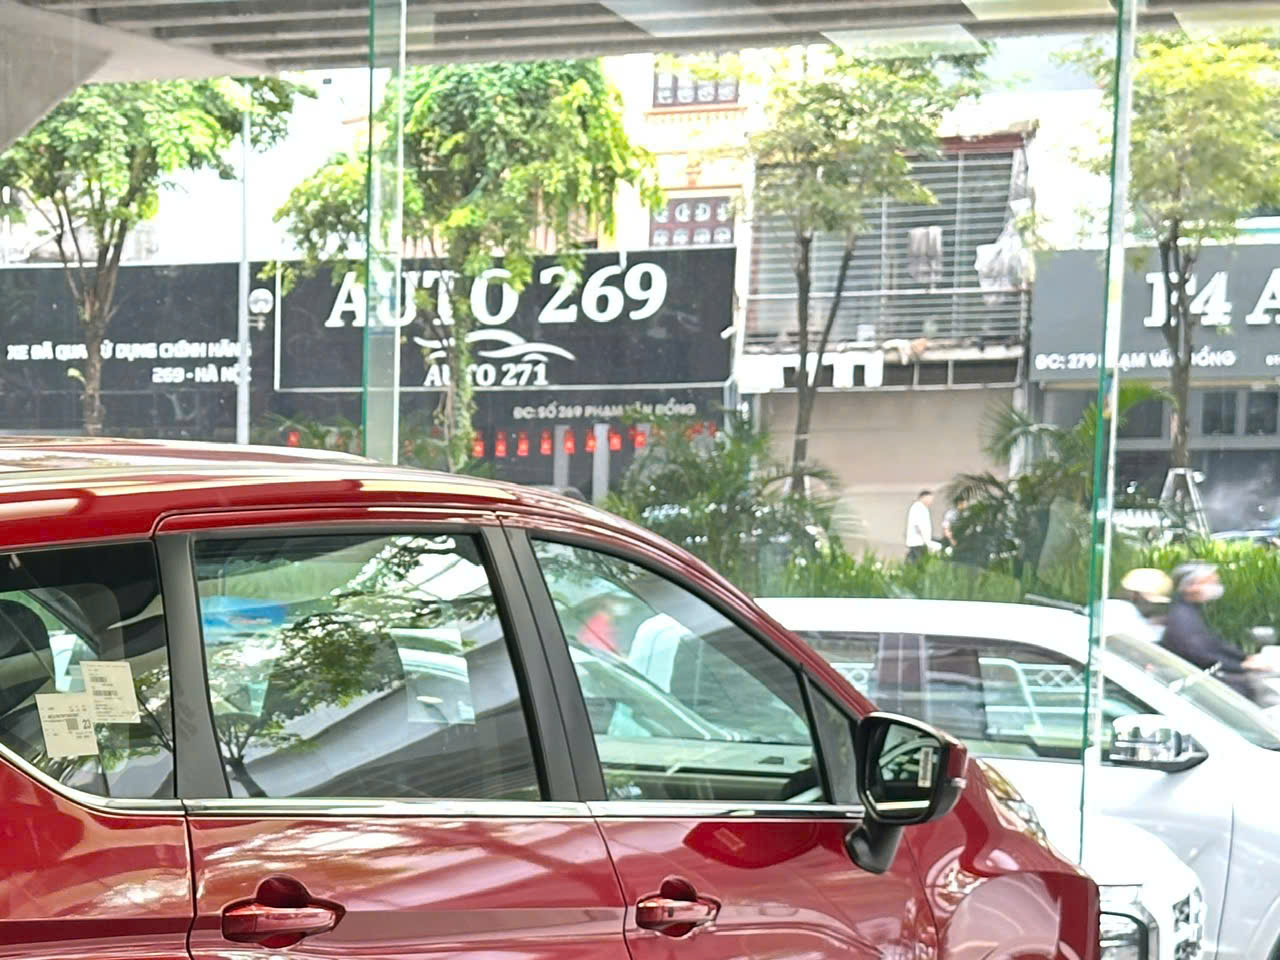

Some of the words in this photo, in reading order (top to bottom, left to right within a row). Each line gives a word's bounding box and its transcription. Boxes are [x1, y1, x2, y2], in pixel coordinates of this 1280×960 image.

[538, 261, 668, 323] 269
[7, 344, 30, 360] XE
[195, 363, 219, 383] HÀ
[501, 362, 549, 386] 271
